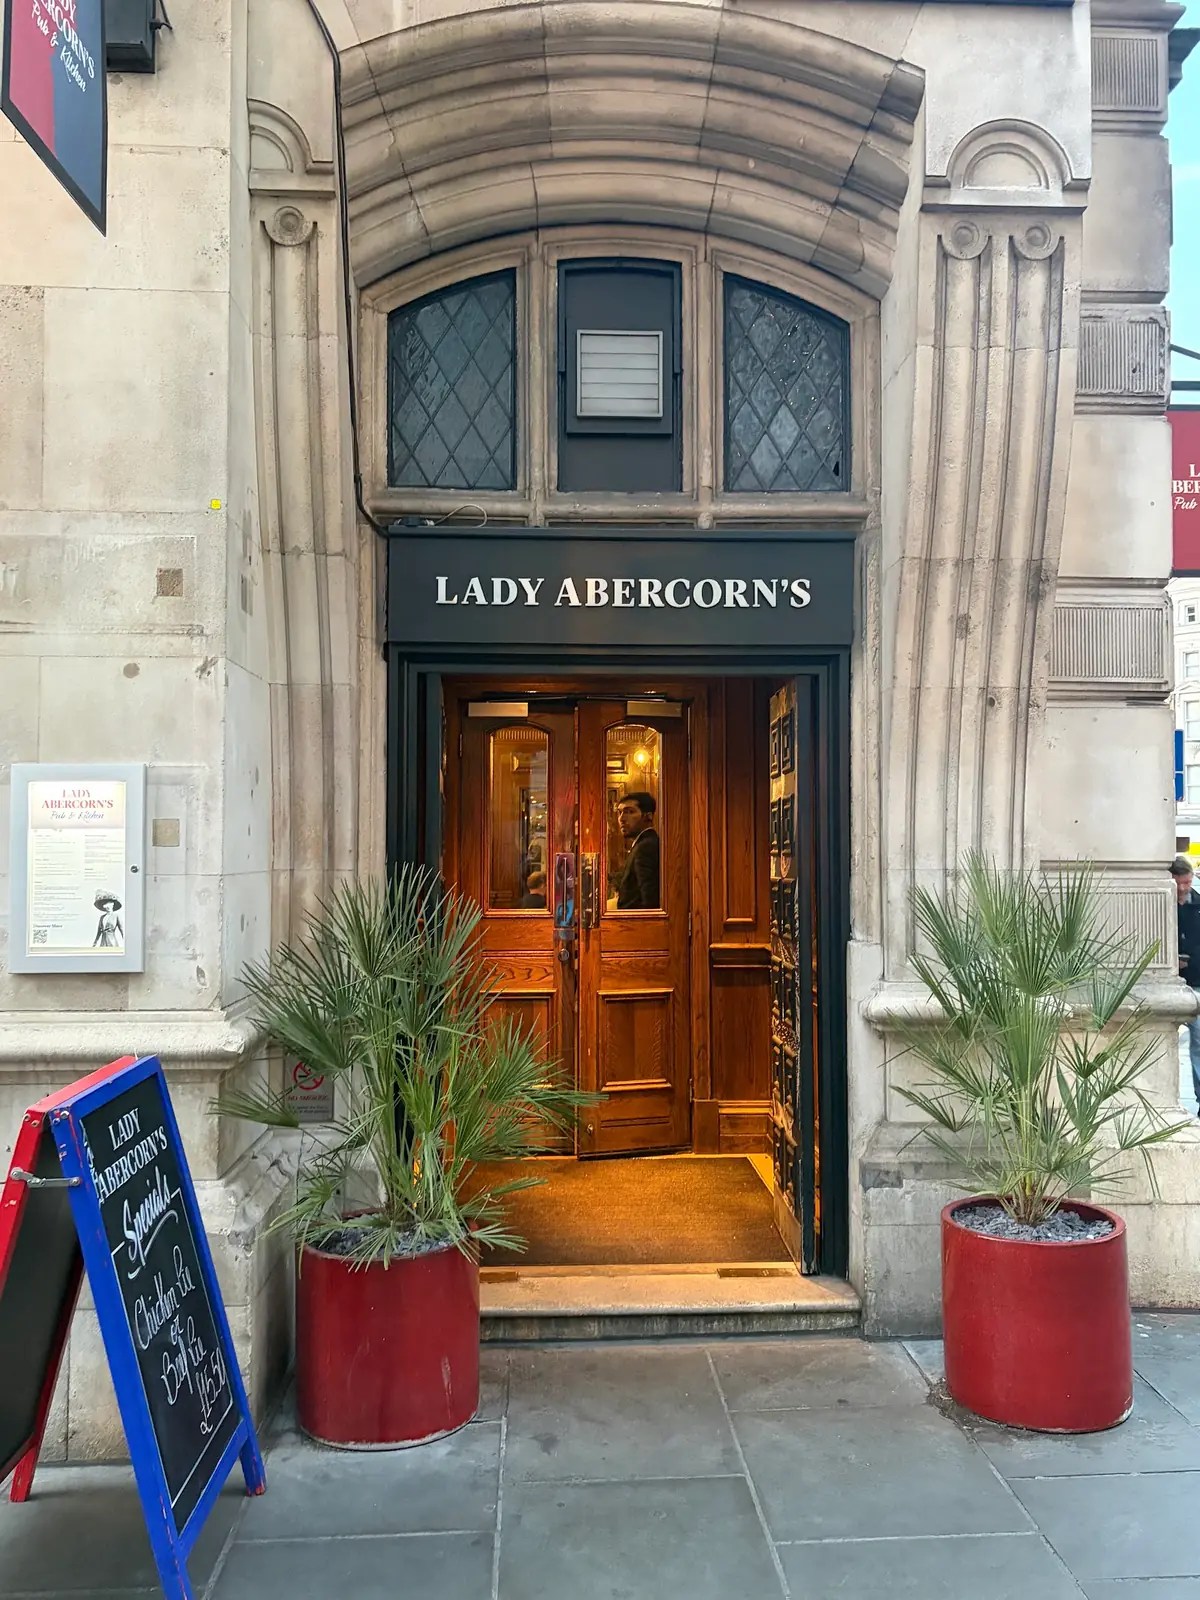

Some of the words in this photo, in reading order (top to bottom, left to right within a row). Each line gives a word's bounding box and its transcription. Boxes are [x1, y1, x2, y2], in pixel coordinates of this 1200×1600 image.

[50, 31, 59, 47] &
[60, 45, 86, 93] Kitchen
[1189, 463, 1200, 478] L
[1173, 496, 1198, 510] Pub
[435, 576, 545, 606] LADY
[553, 577, 812, 609] ABERCORN'S
[41, 799, 114, 809] ABERCORN'S
[62, 789, 91, 798] LADY
[50, 810, 66, 820] Pub
[77, 810, 104, 823] Kitchen
[108, 1107, 141, 1151] LADY
[98, 1125, 168, 1204] ABERCORN'S
[123, 1165, 171, 1267] Specials
[134, 1271, 180, 1350] Chicken
[173, 1245, 196, 1298] Pie
[187, 1315, 207, 1367] Pie
